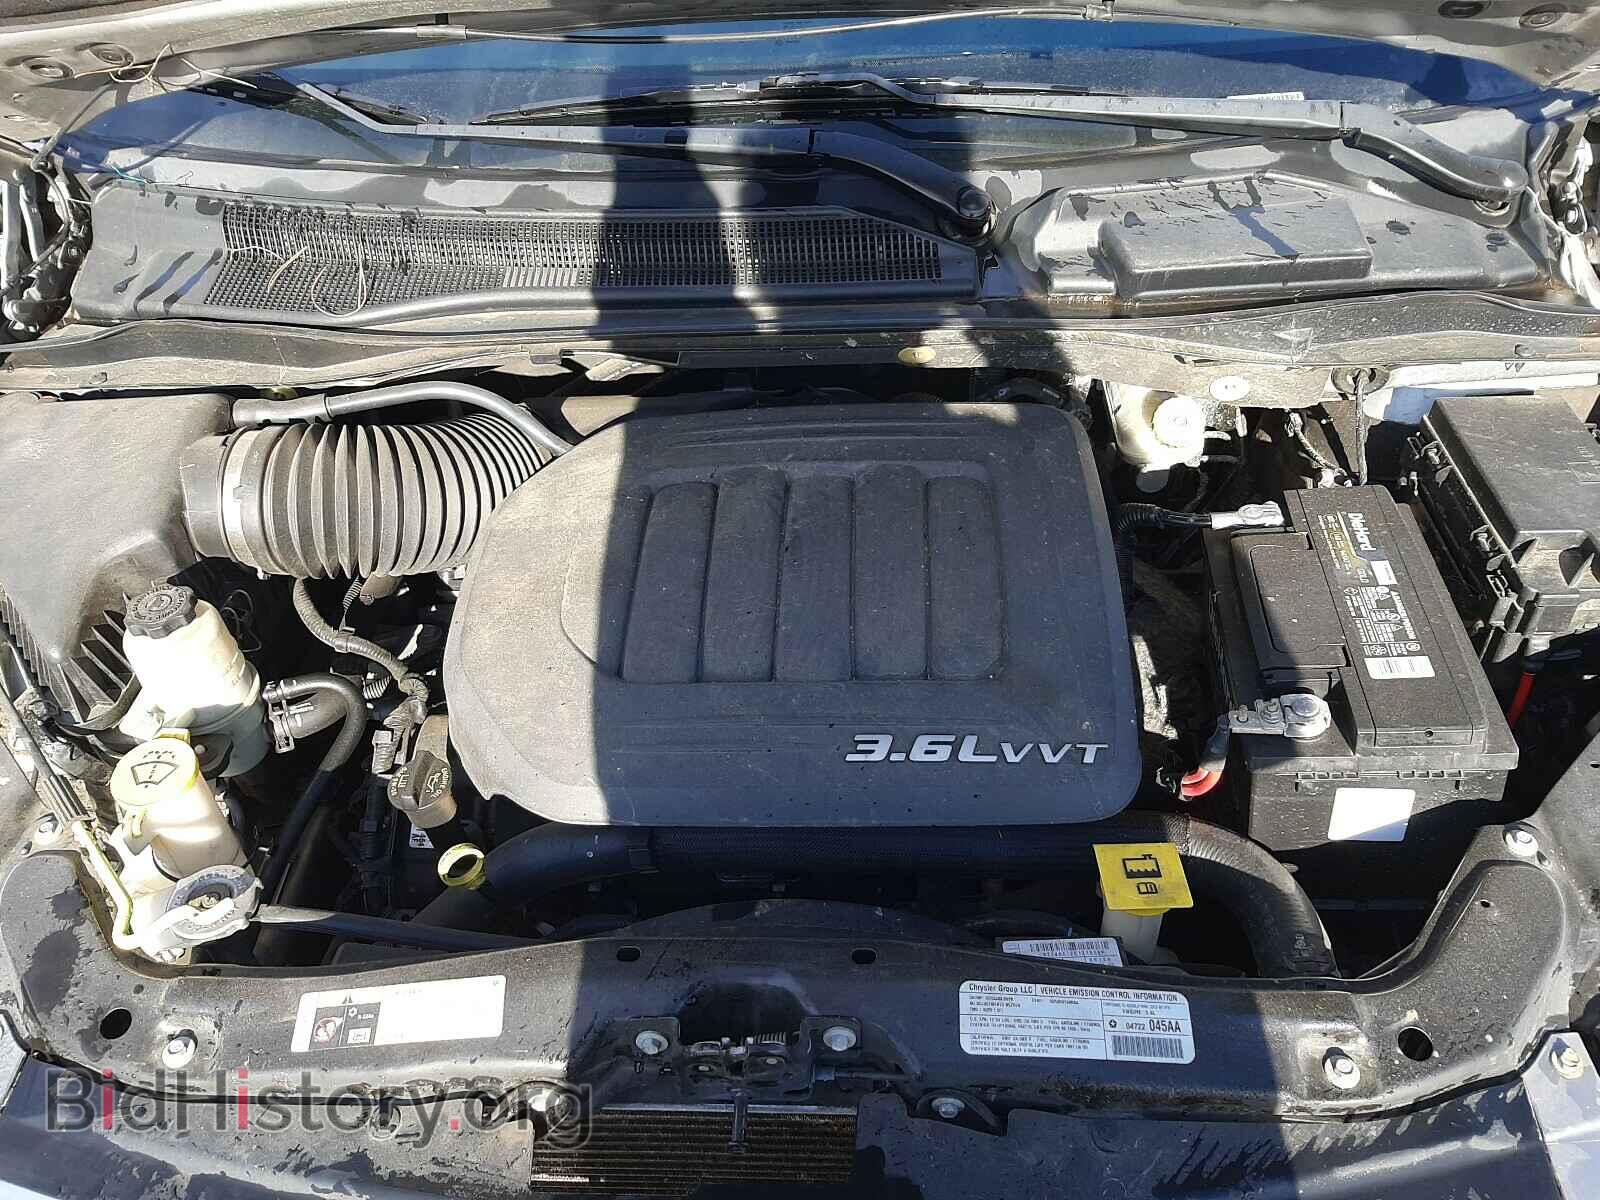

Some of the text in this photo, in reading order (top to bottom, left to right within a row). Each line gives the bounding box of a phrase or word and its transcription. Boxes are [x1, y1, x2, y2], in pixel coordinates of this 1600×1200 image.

[1347, 512, 1377, 551] DieHard
[845, 734, 1109, 764] 3.6L VVT
[969, 983, 1033, 994] Chrysler Group LLC
[1040, 986, 1178, 1002] VEHICLE EMISSION CONTROL INFORMATION
[1125, 1019, 1182, 1033] 04722 045AA
